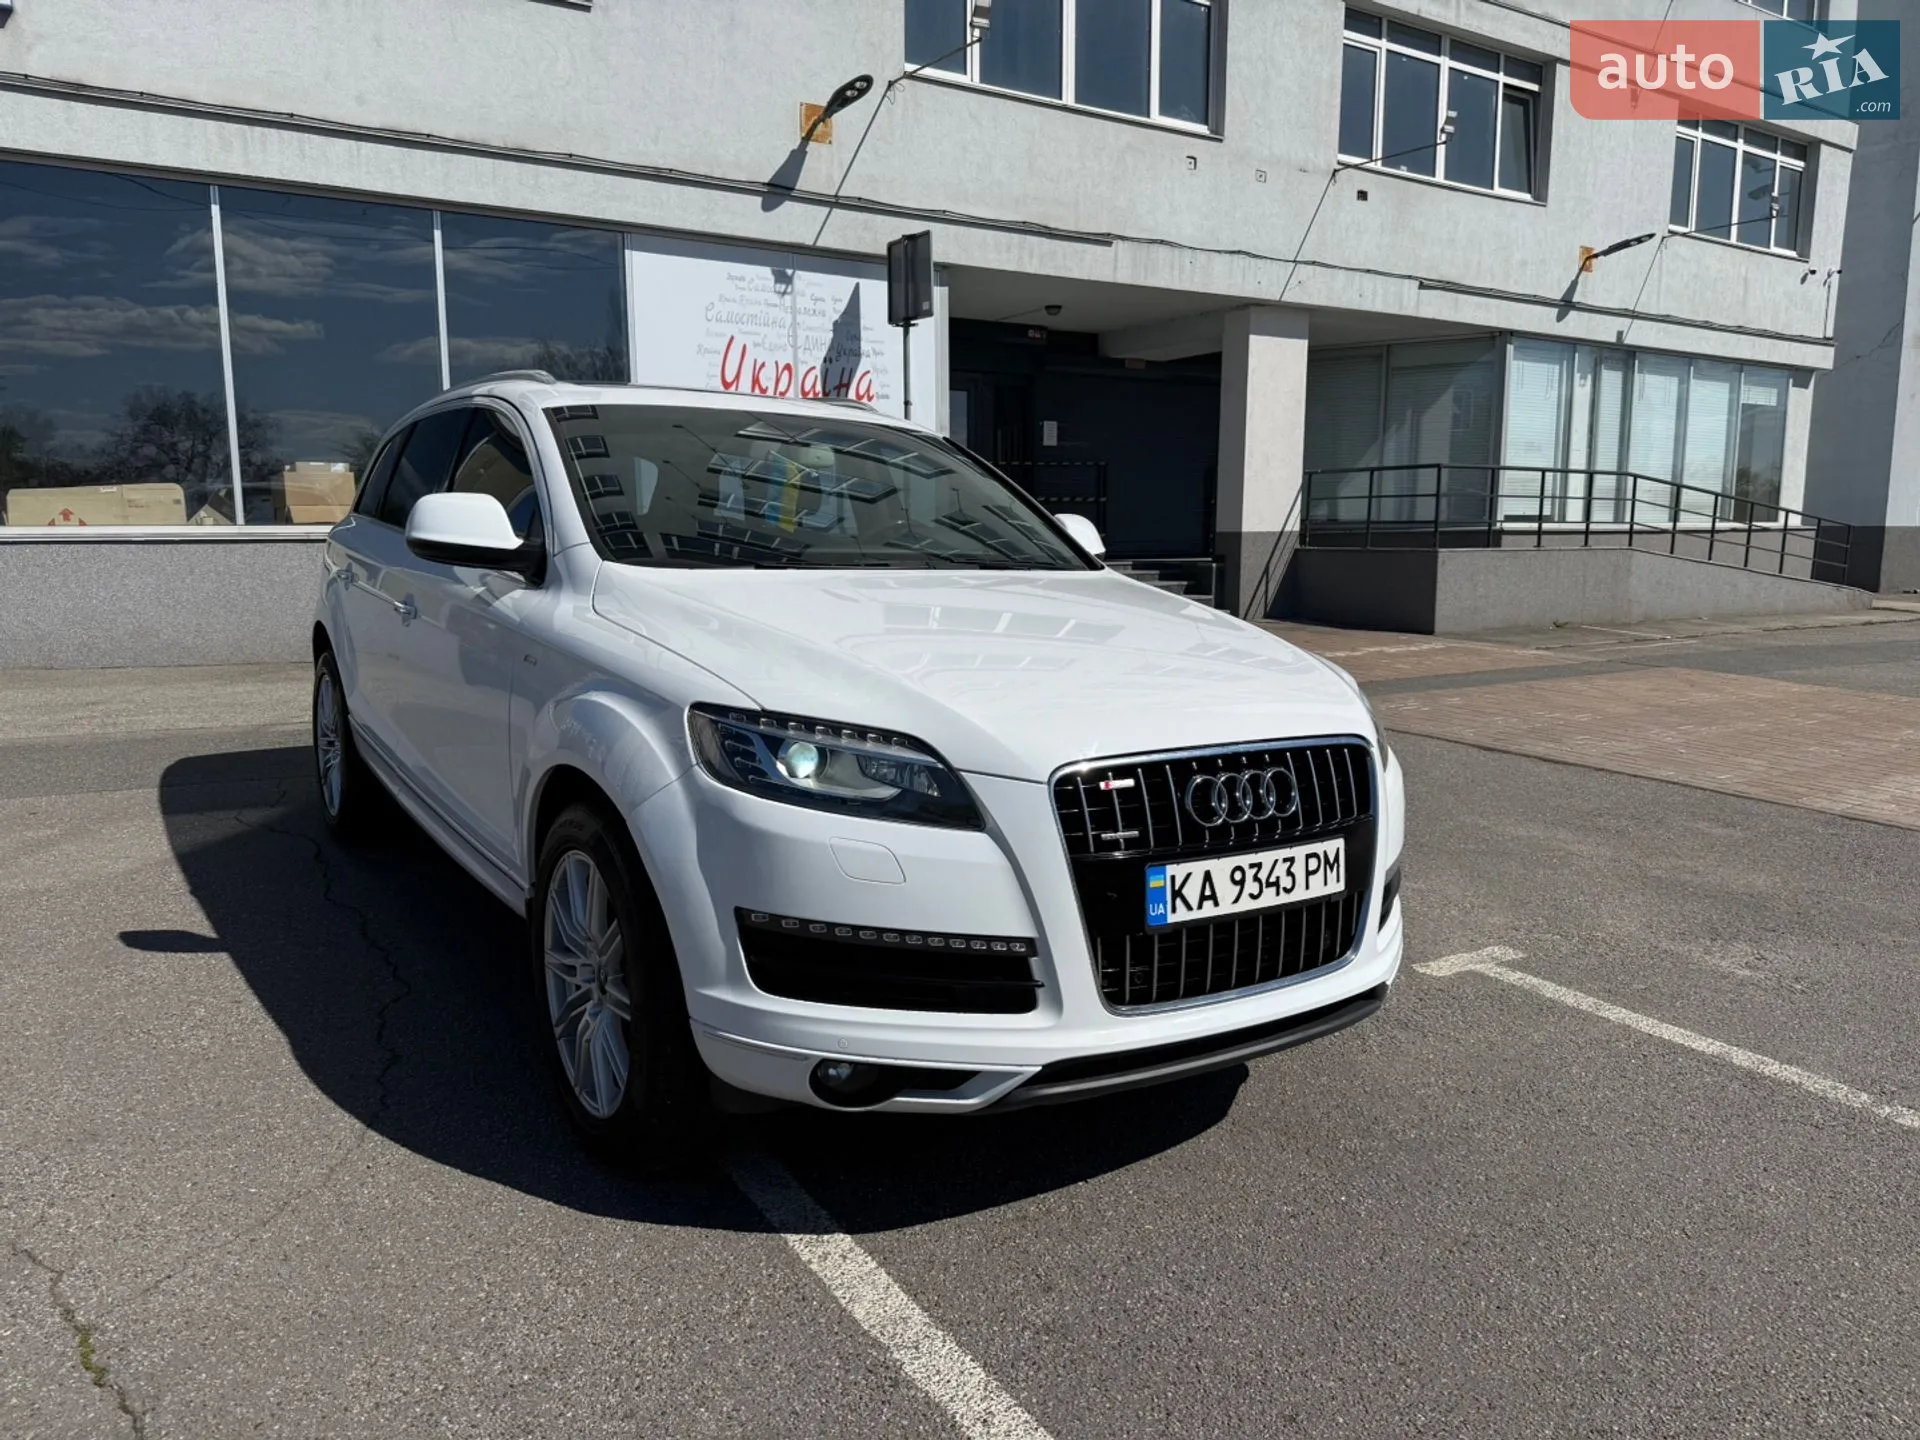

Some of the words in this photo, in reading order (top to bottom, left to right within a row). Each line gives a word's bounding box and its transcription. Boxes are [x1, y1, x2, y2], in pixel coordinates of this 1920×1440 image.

[720, 334, 875, 402] Україна
[1149, 903, 1165, 917] UA
[1169, 869, 1220, 914] KA
[1229, 855, 1296, 906] 9343
[1305, 846, 1341, 891] PM
